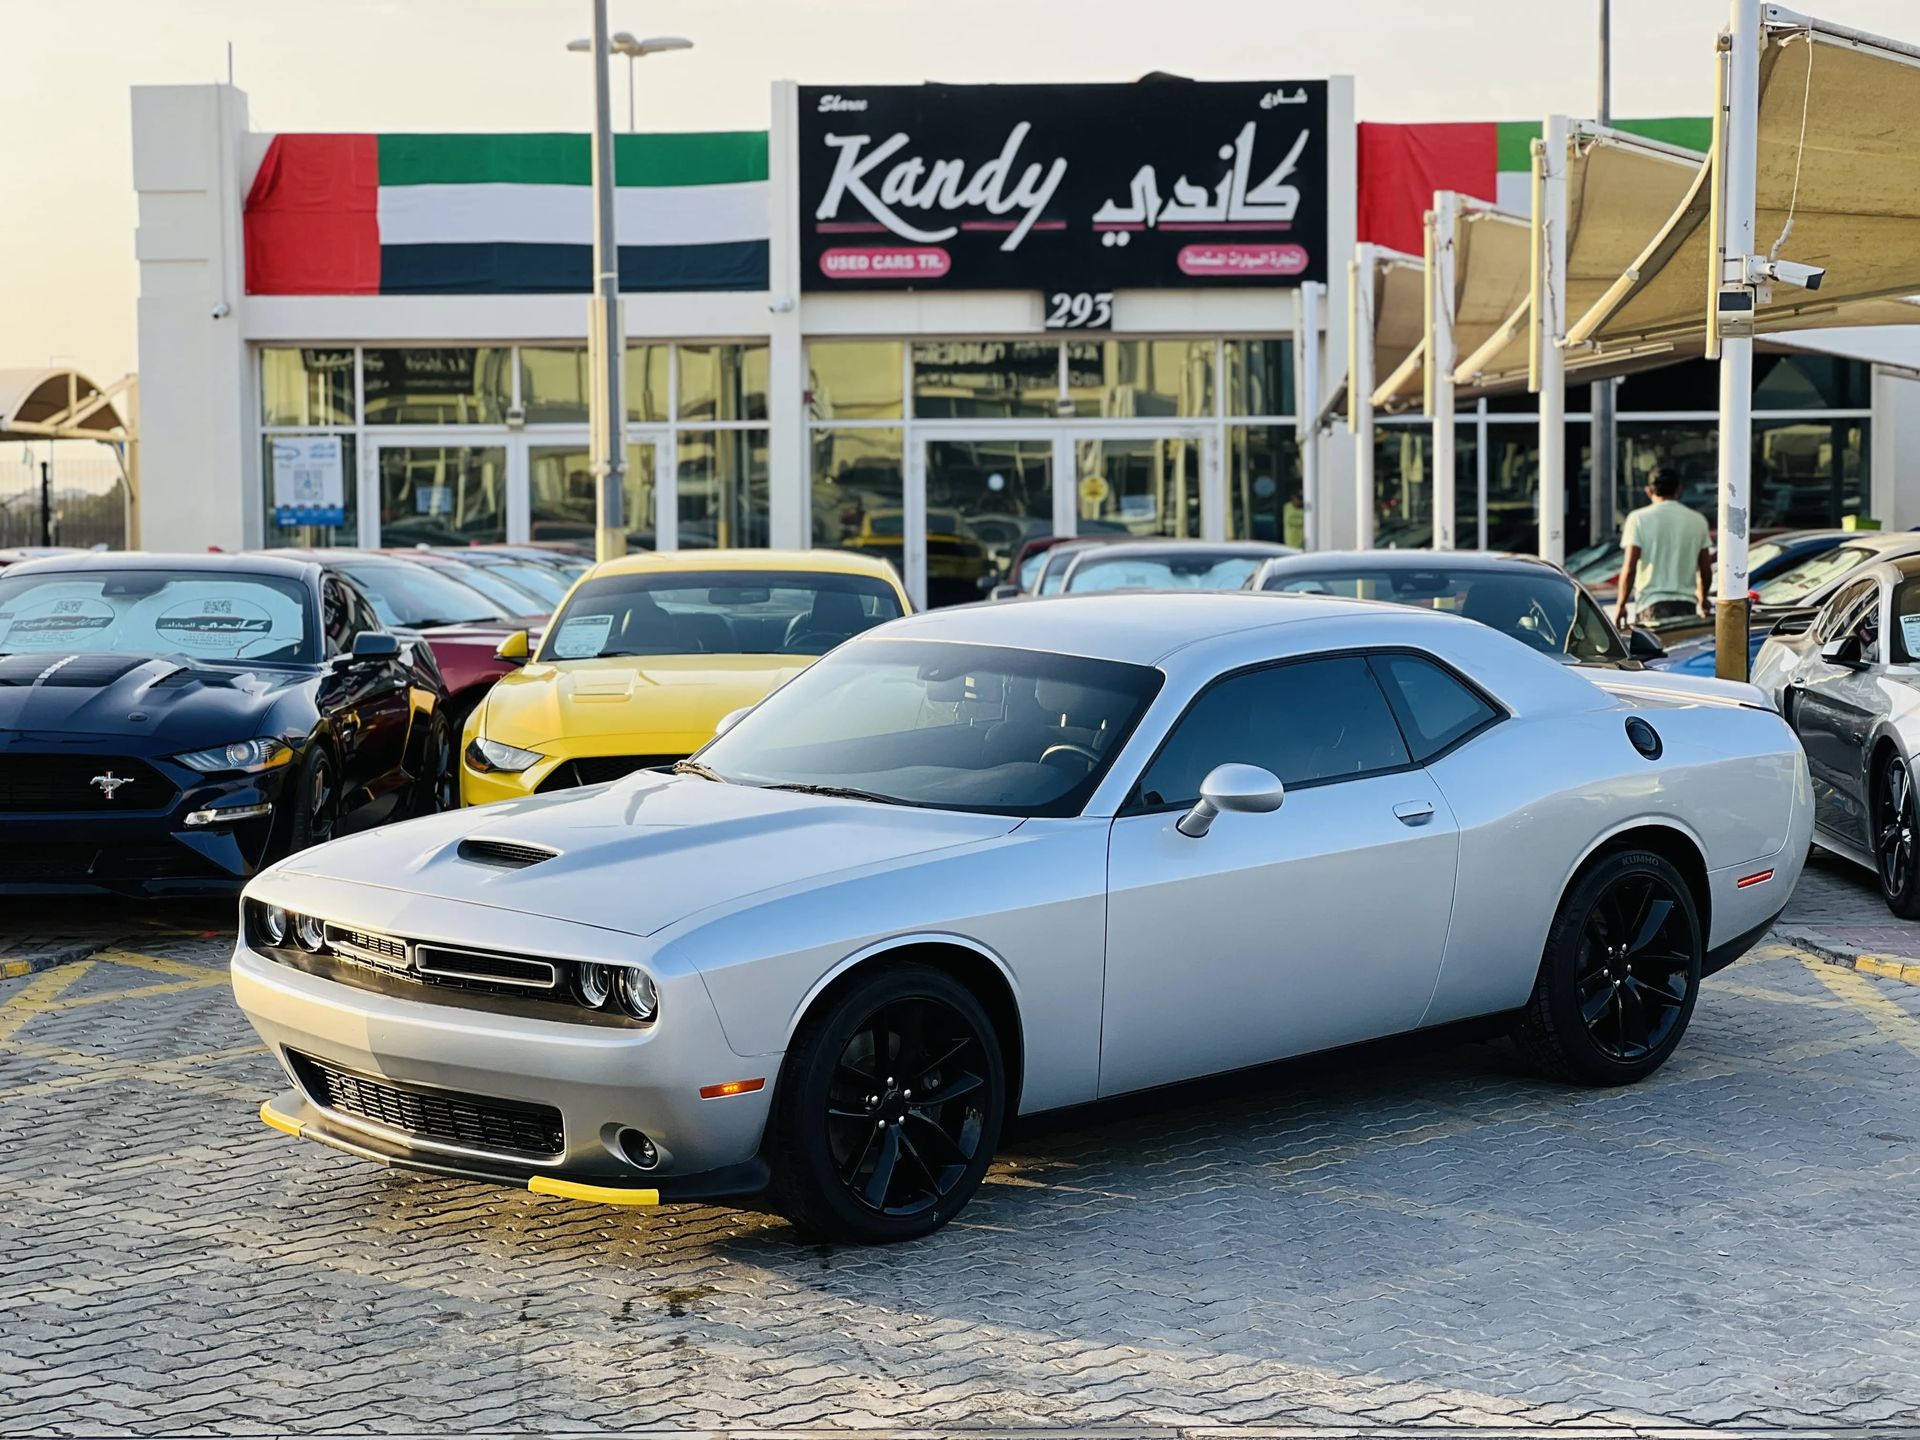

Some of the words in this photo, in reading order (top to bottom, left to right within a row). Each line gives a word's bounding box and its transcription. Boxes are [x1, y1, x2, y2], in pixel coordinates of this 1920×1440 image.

[816, 121, 1067, 251] Kandy
[1092, 121, 1309, 247] كاندي
[826, 255, 870, 270] USED
[871, 254, 915, 270] CARS
[1622, 855, 1659, 866] KUMHO
